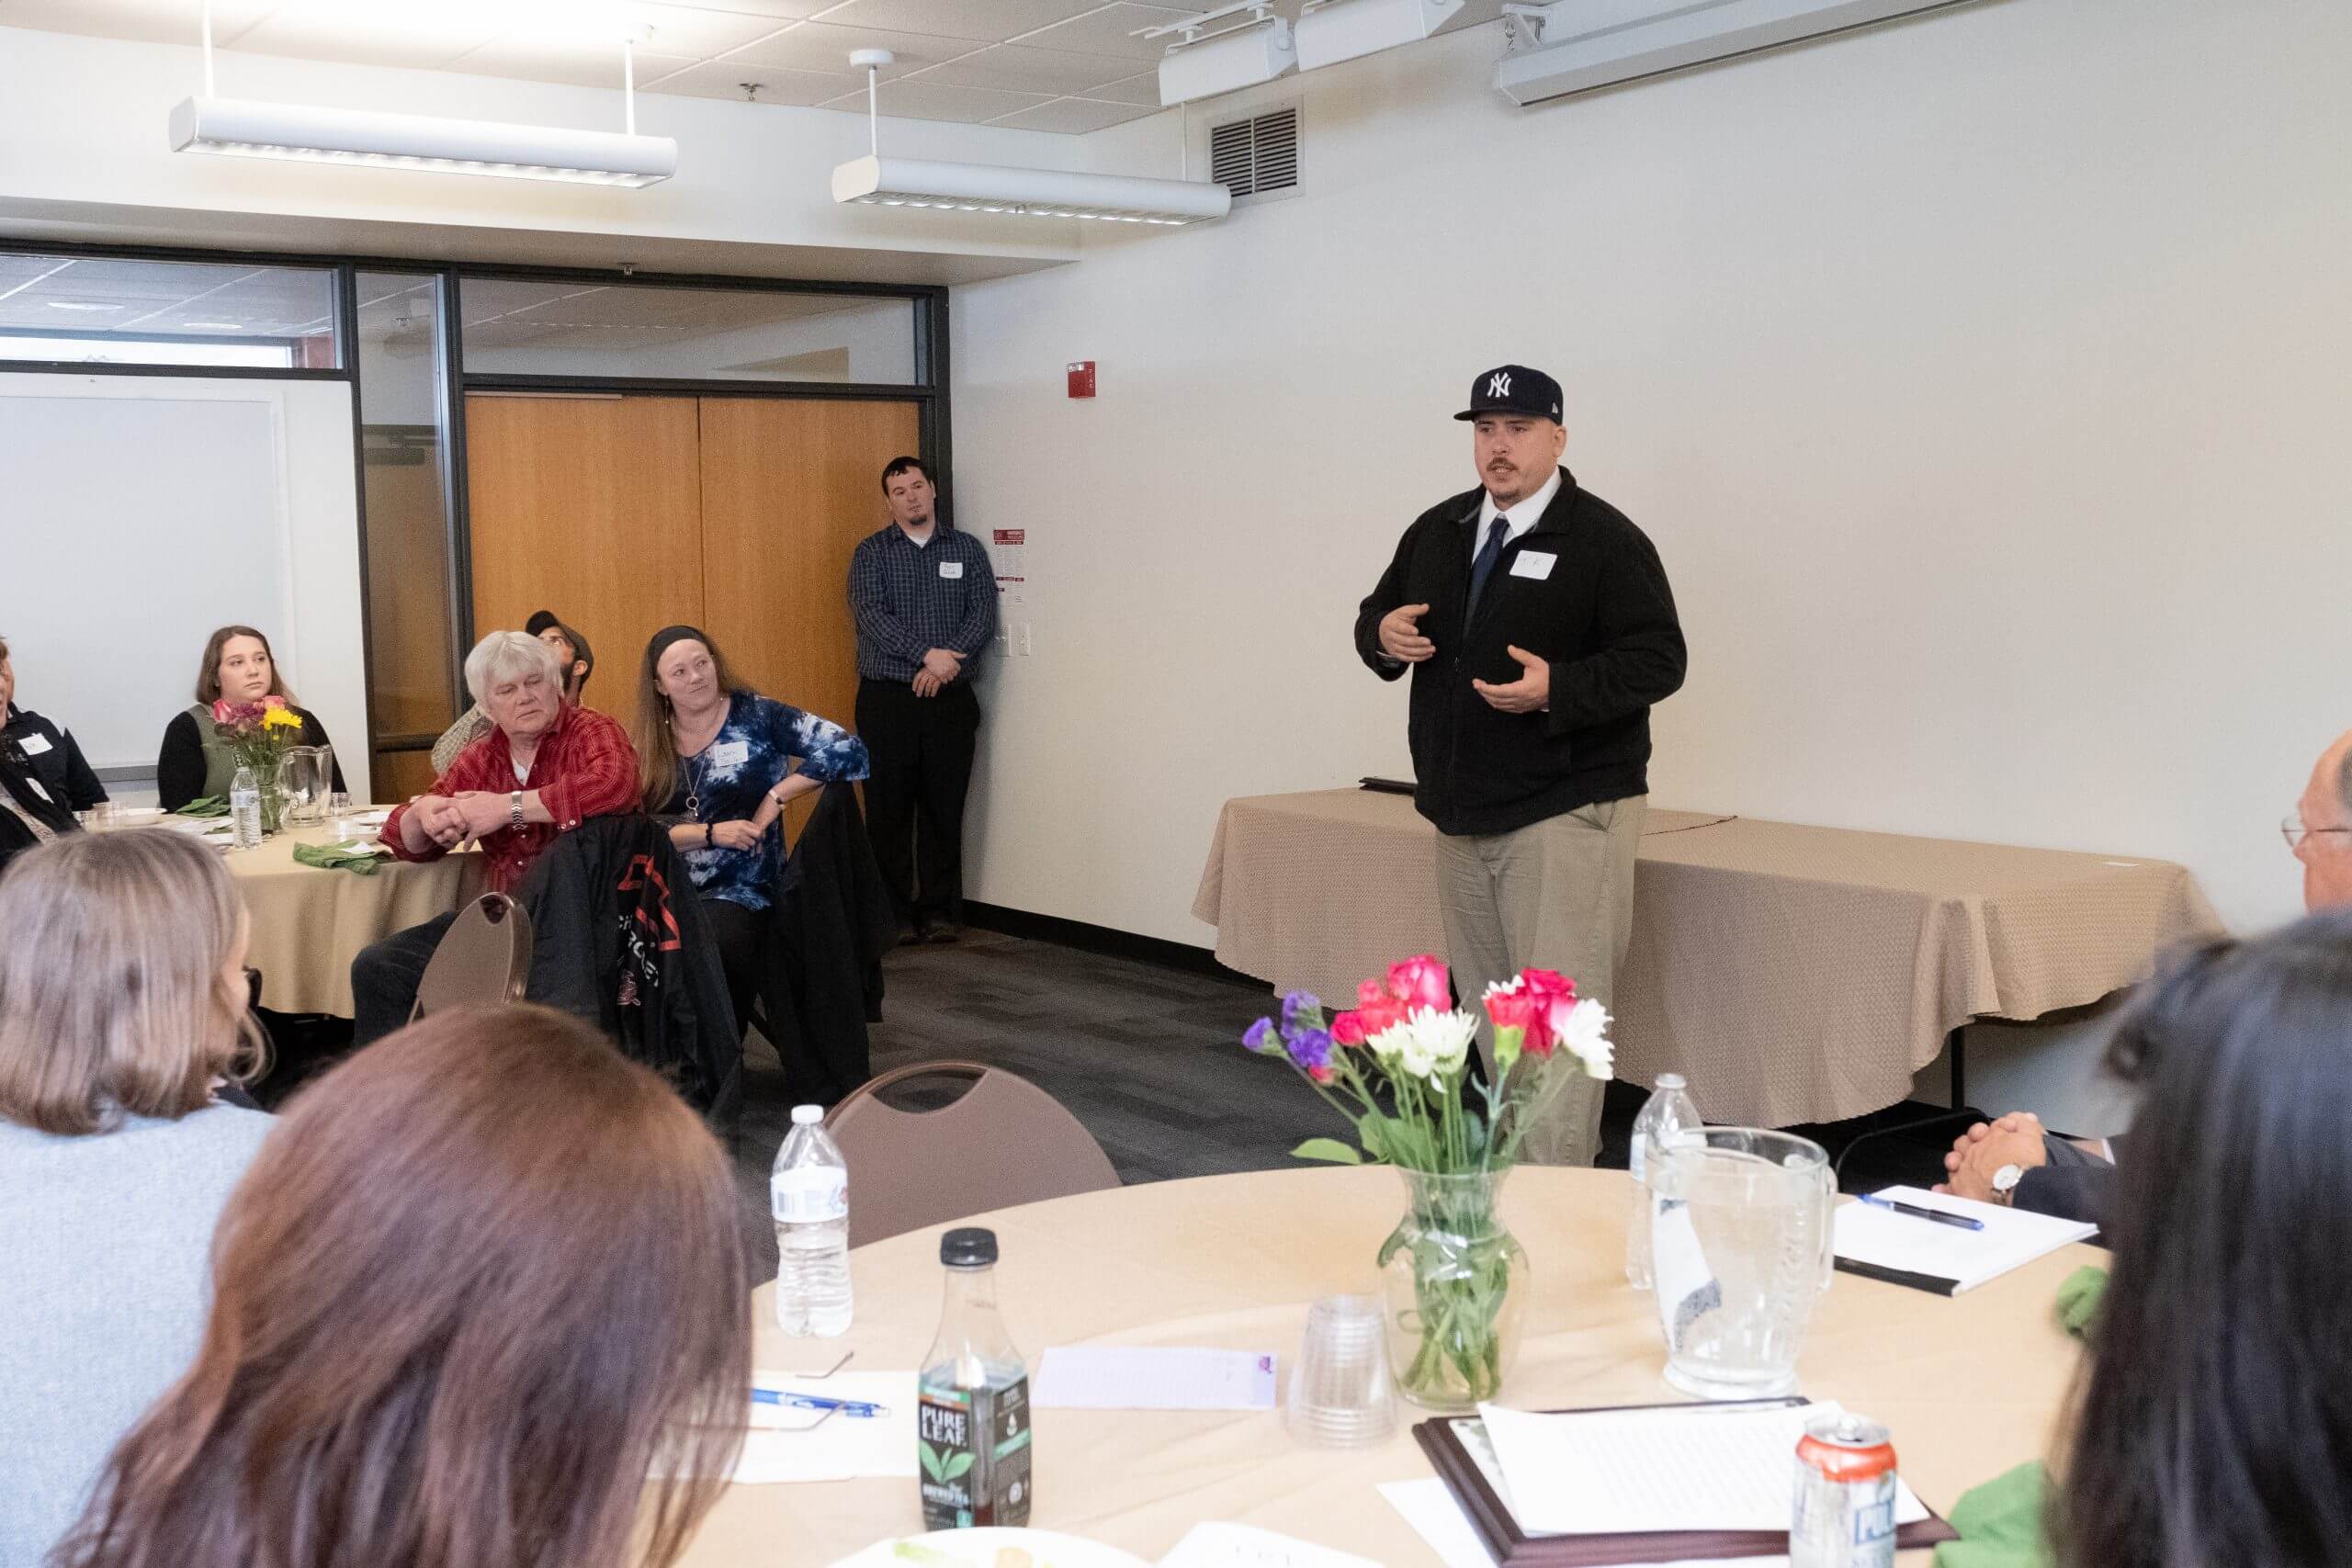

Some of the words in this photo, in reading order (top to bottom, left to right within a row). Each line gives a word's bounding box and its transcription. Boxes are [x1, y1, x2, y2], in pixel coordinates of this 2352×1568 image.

[1487, 372, 1512, 398] NY
[922, 1404, 966, 1429] PURE
[922, 1419, 966, 1447] LEAF
